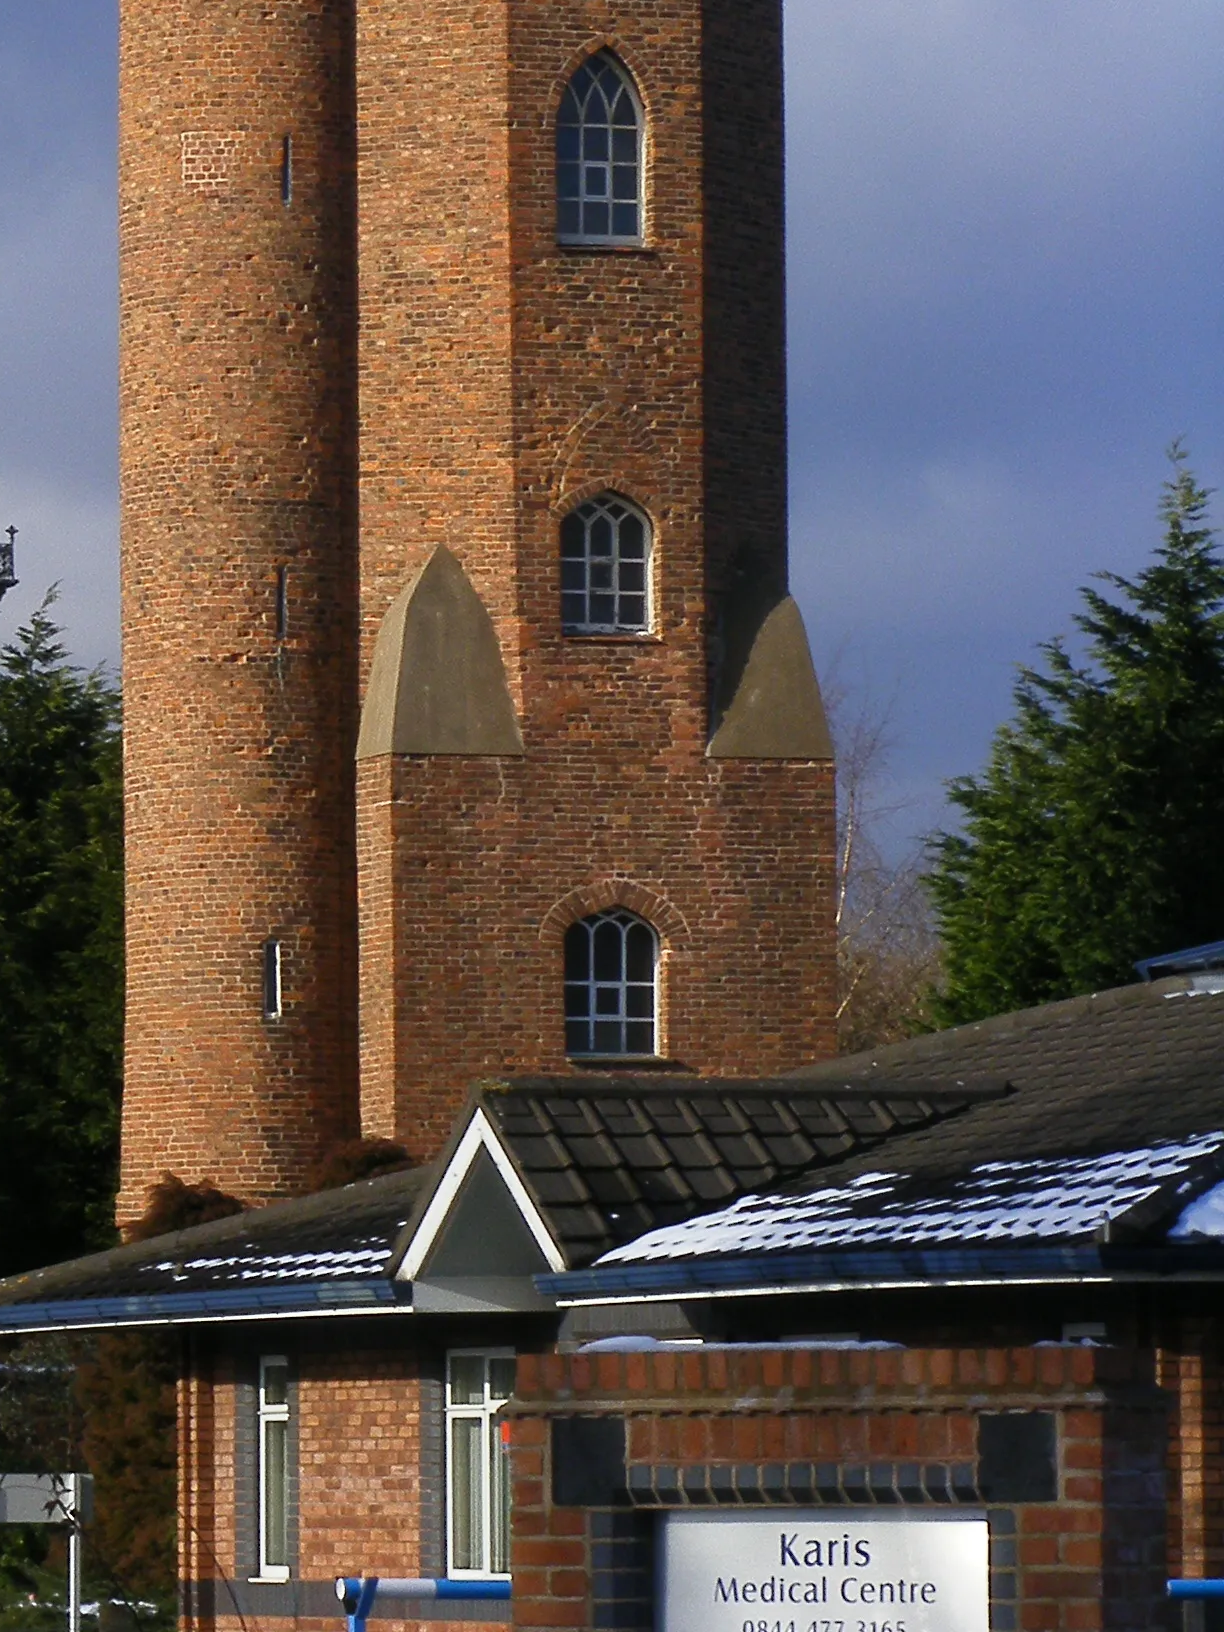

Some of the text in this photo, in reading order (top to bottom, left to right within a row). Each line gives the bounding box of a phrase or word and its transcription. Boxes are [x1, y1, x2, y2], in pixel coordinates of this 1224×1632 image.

[779, 1532, 871, 1568] Karis
[713, 1575, 937, 1604] Medical Centre
